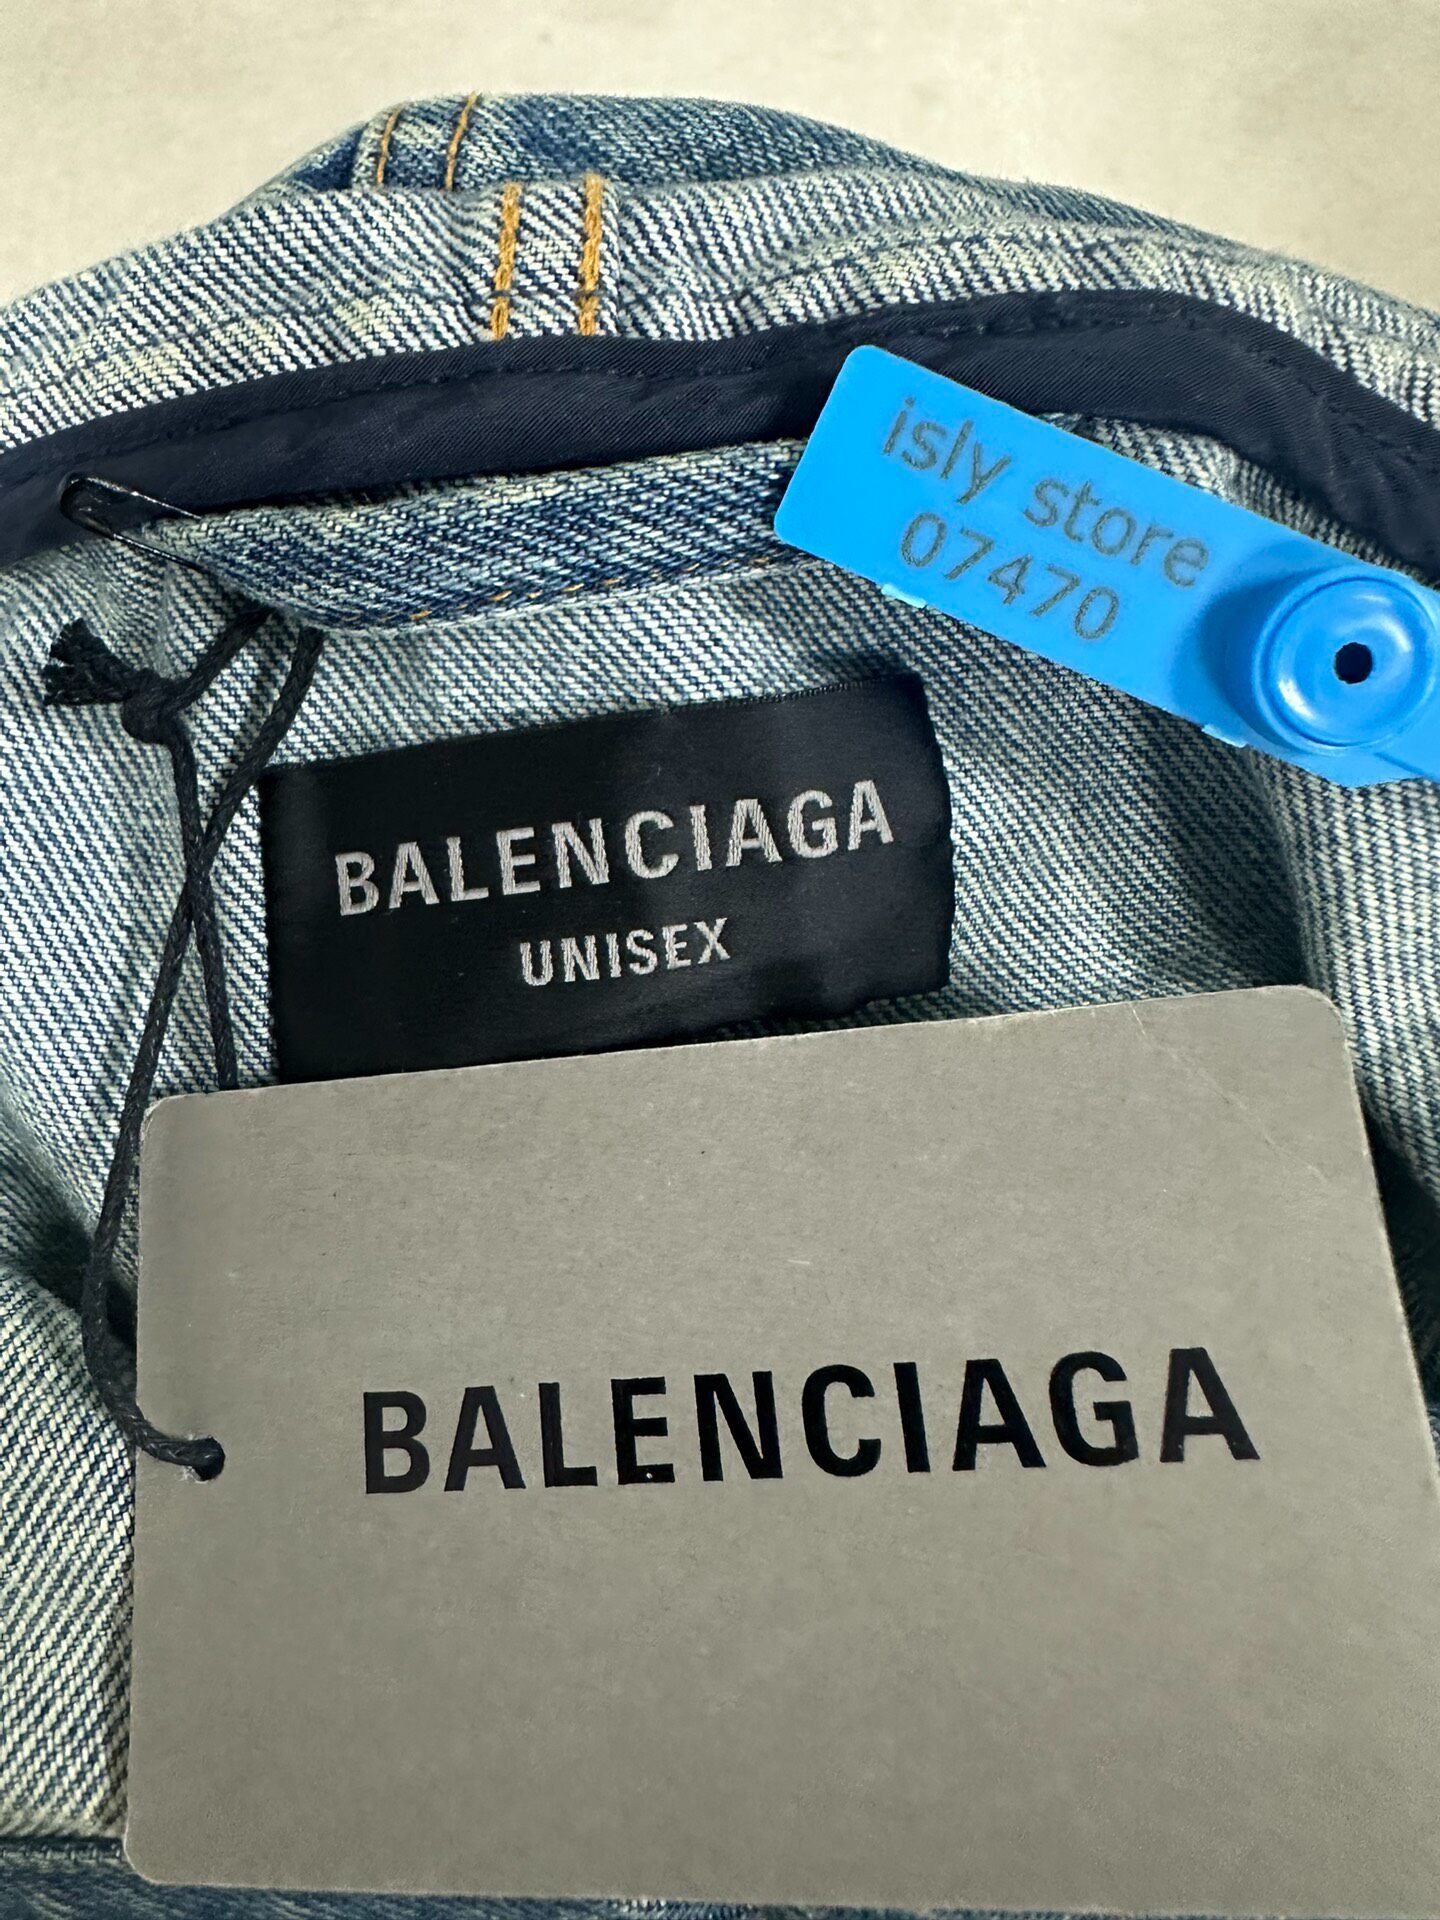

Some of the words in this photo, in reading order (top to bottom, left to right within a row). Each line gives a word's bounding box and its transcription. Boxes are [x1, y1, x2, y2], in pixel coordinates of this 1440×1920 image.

[881, 397, 1012, 505] isly
[1023, 477, 1210, 588] store
[900, 512, 1119, 640] 07470
[335, 779, 895, 916] BALENCIAGA
[520, 918, 731, 987] UNISEX
[362, 1347, 1260, 1494] BALENCIAGA
